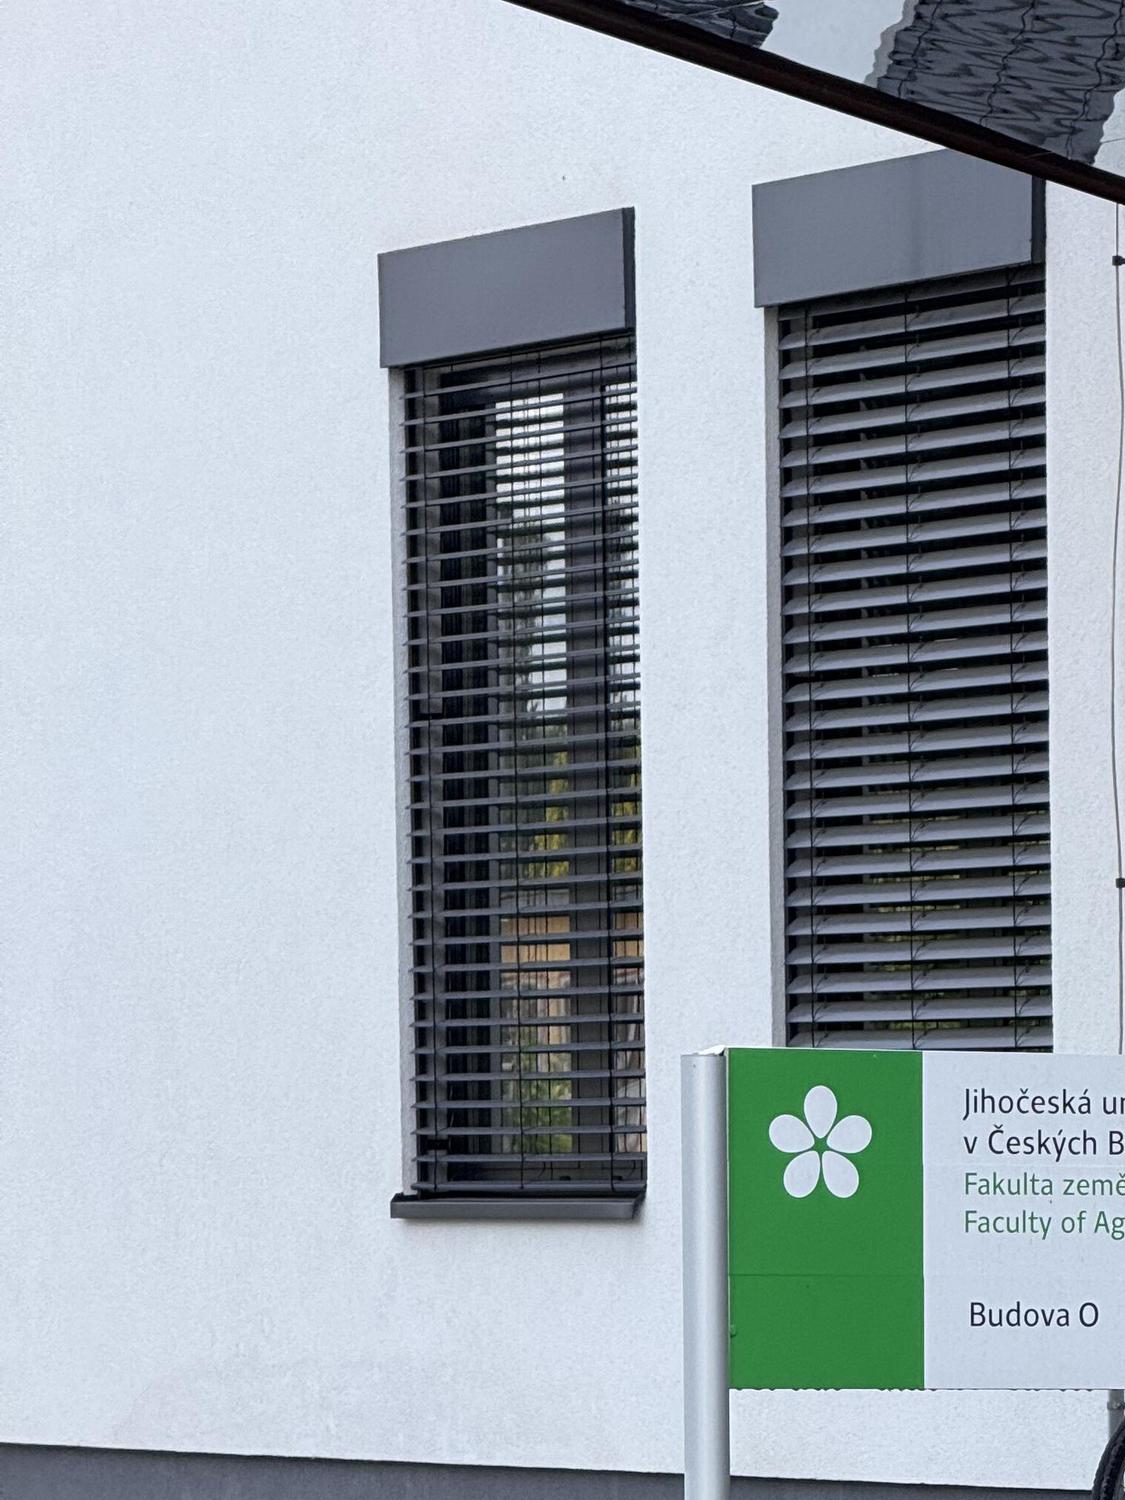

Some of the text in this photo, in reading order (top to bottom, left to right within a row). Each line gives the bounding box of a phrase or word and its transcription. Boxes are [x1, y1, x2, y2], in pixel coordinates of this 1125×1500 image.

[963, 1088, 1091, 1121] Jihočeská
[963, 1135, 978, 1155] v
[988, 1124, 1096, 1162] Českých
[965, 1172, 1053, 1195] Fakulta
[965, 1210, 1052, 1240] Faculty
[1061, 1210, 1087, 1233] of
[970, 1301, 1099, 1327] Budova O
